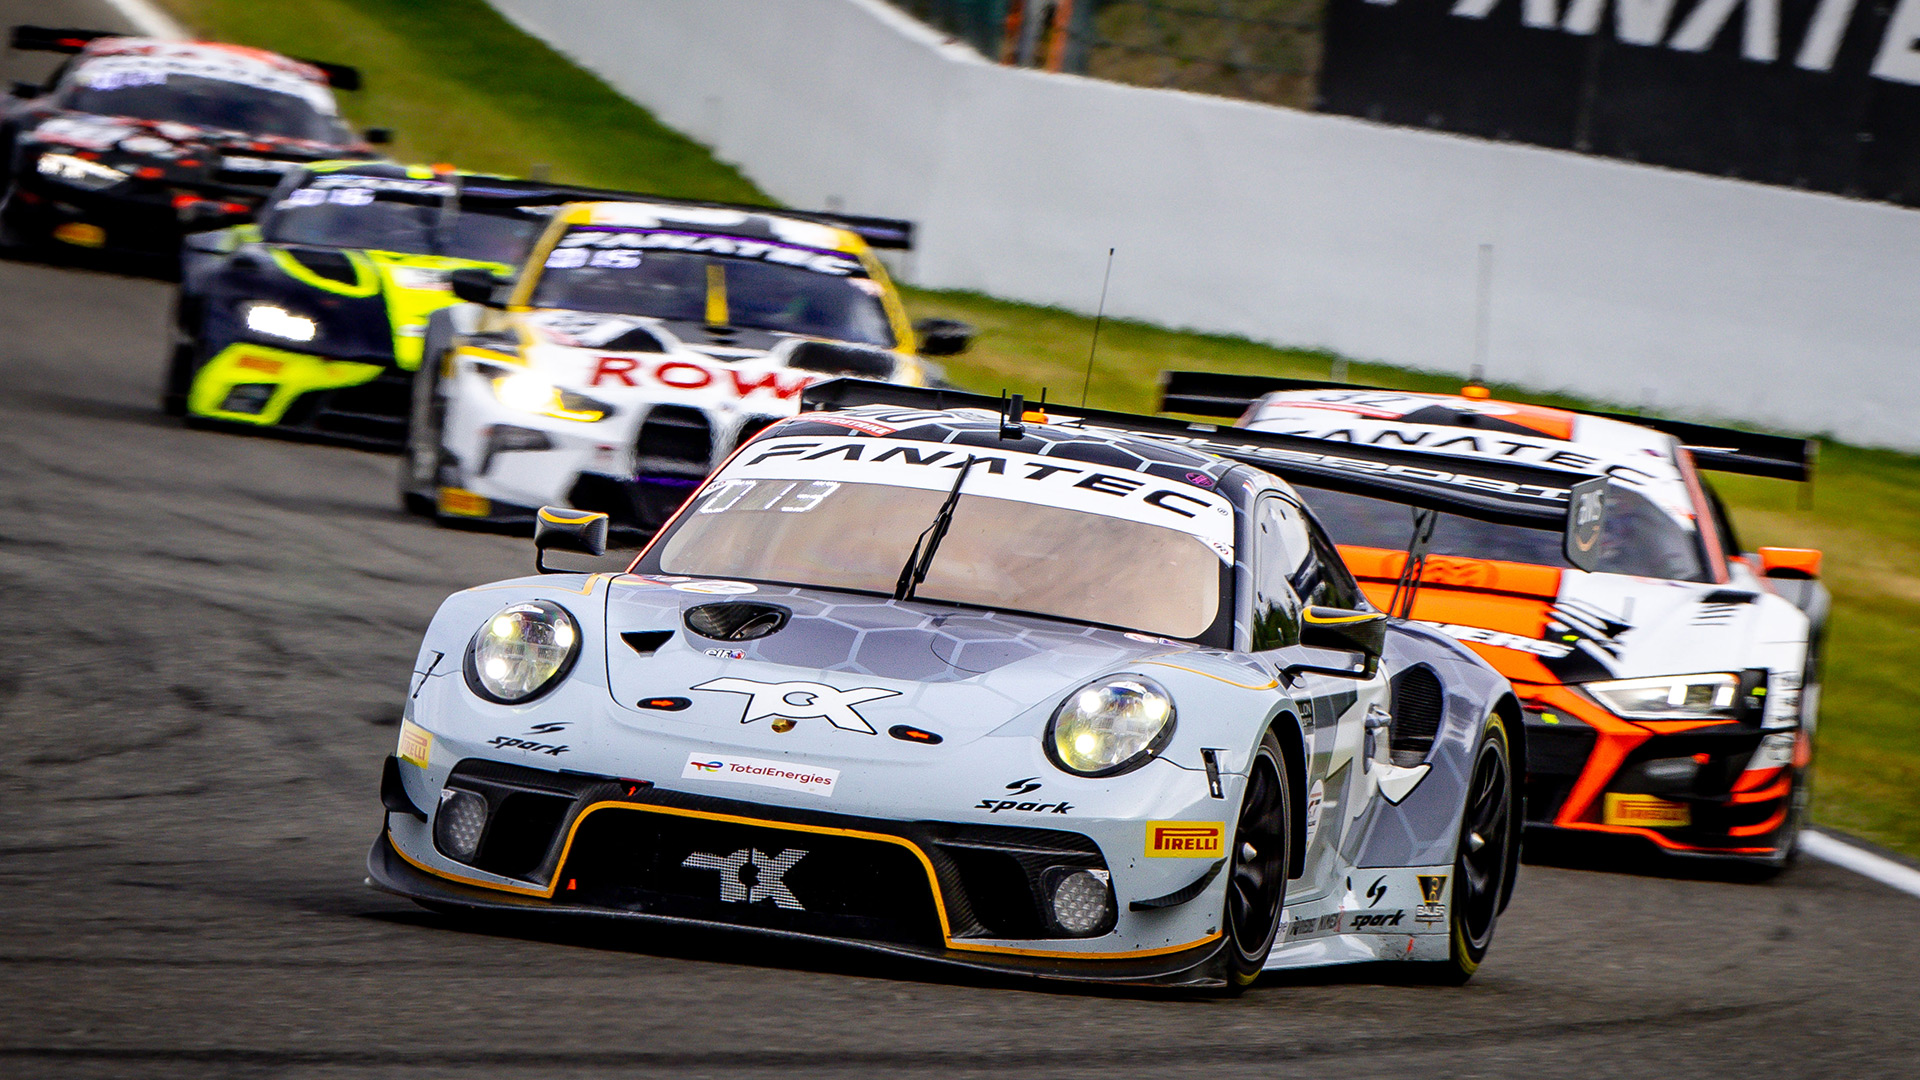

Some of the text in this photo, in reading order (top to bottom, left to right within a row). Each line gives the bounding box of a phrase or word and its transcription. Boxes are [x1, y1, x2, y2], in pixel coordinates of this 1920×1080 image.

[744, 443, 1212, 519] FANATEC
[704, 648, 732, 660] elf
[486, 735, 573, 757] spark
[729, 762, 832, 786] TotalEnergies
[973, 799, 1076, 815] spark
[1154, 827, 1219, 851] PIRELLI
[1350, 908, 1407, 931] spark
